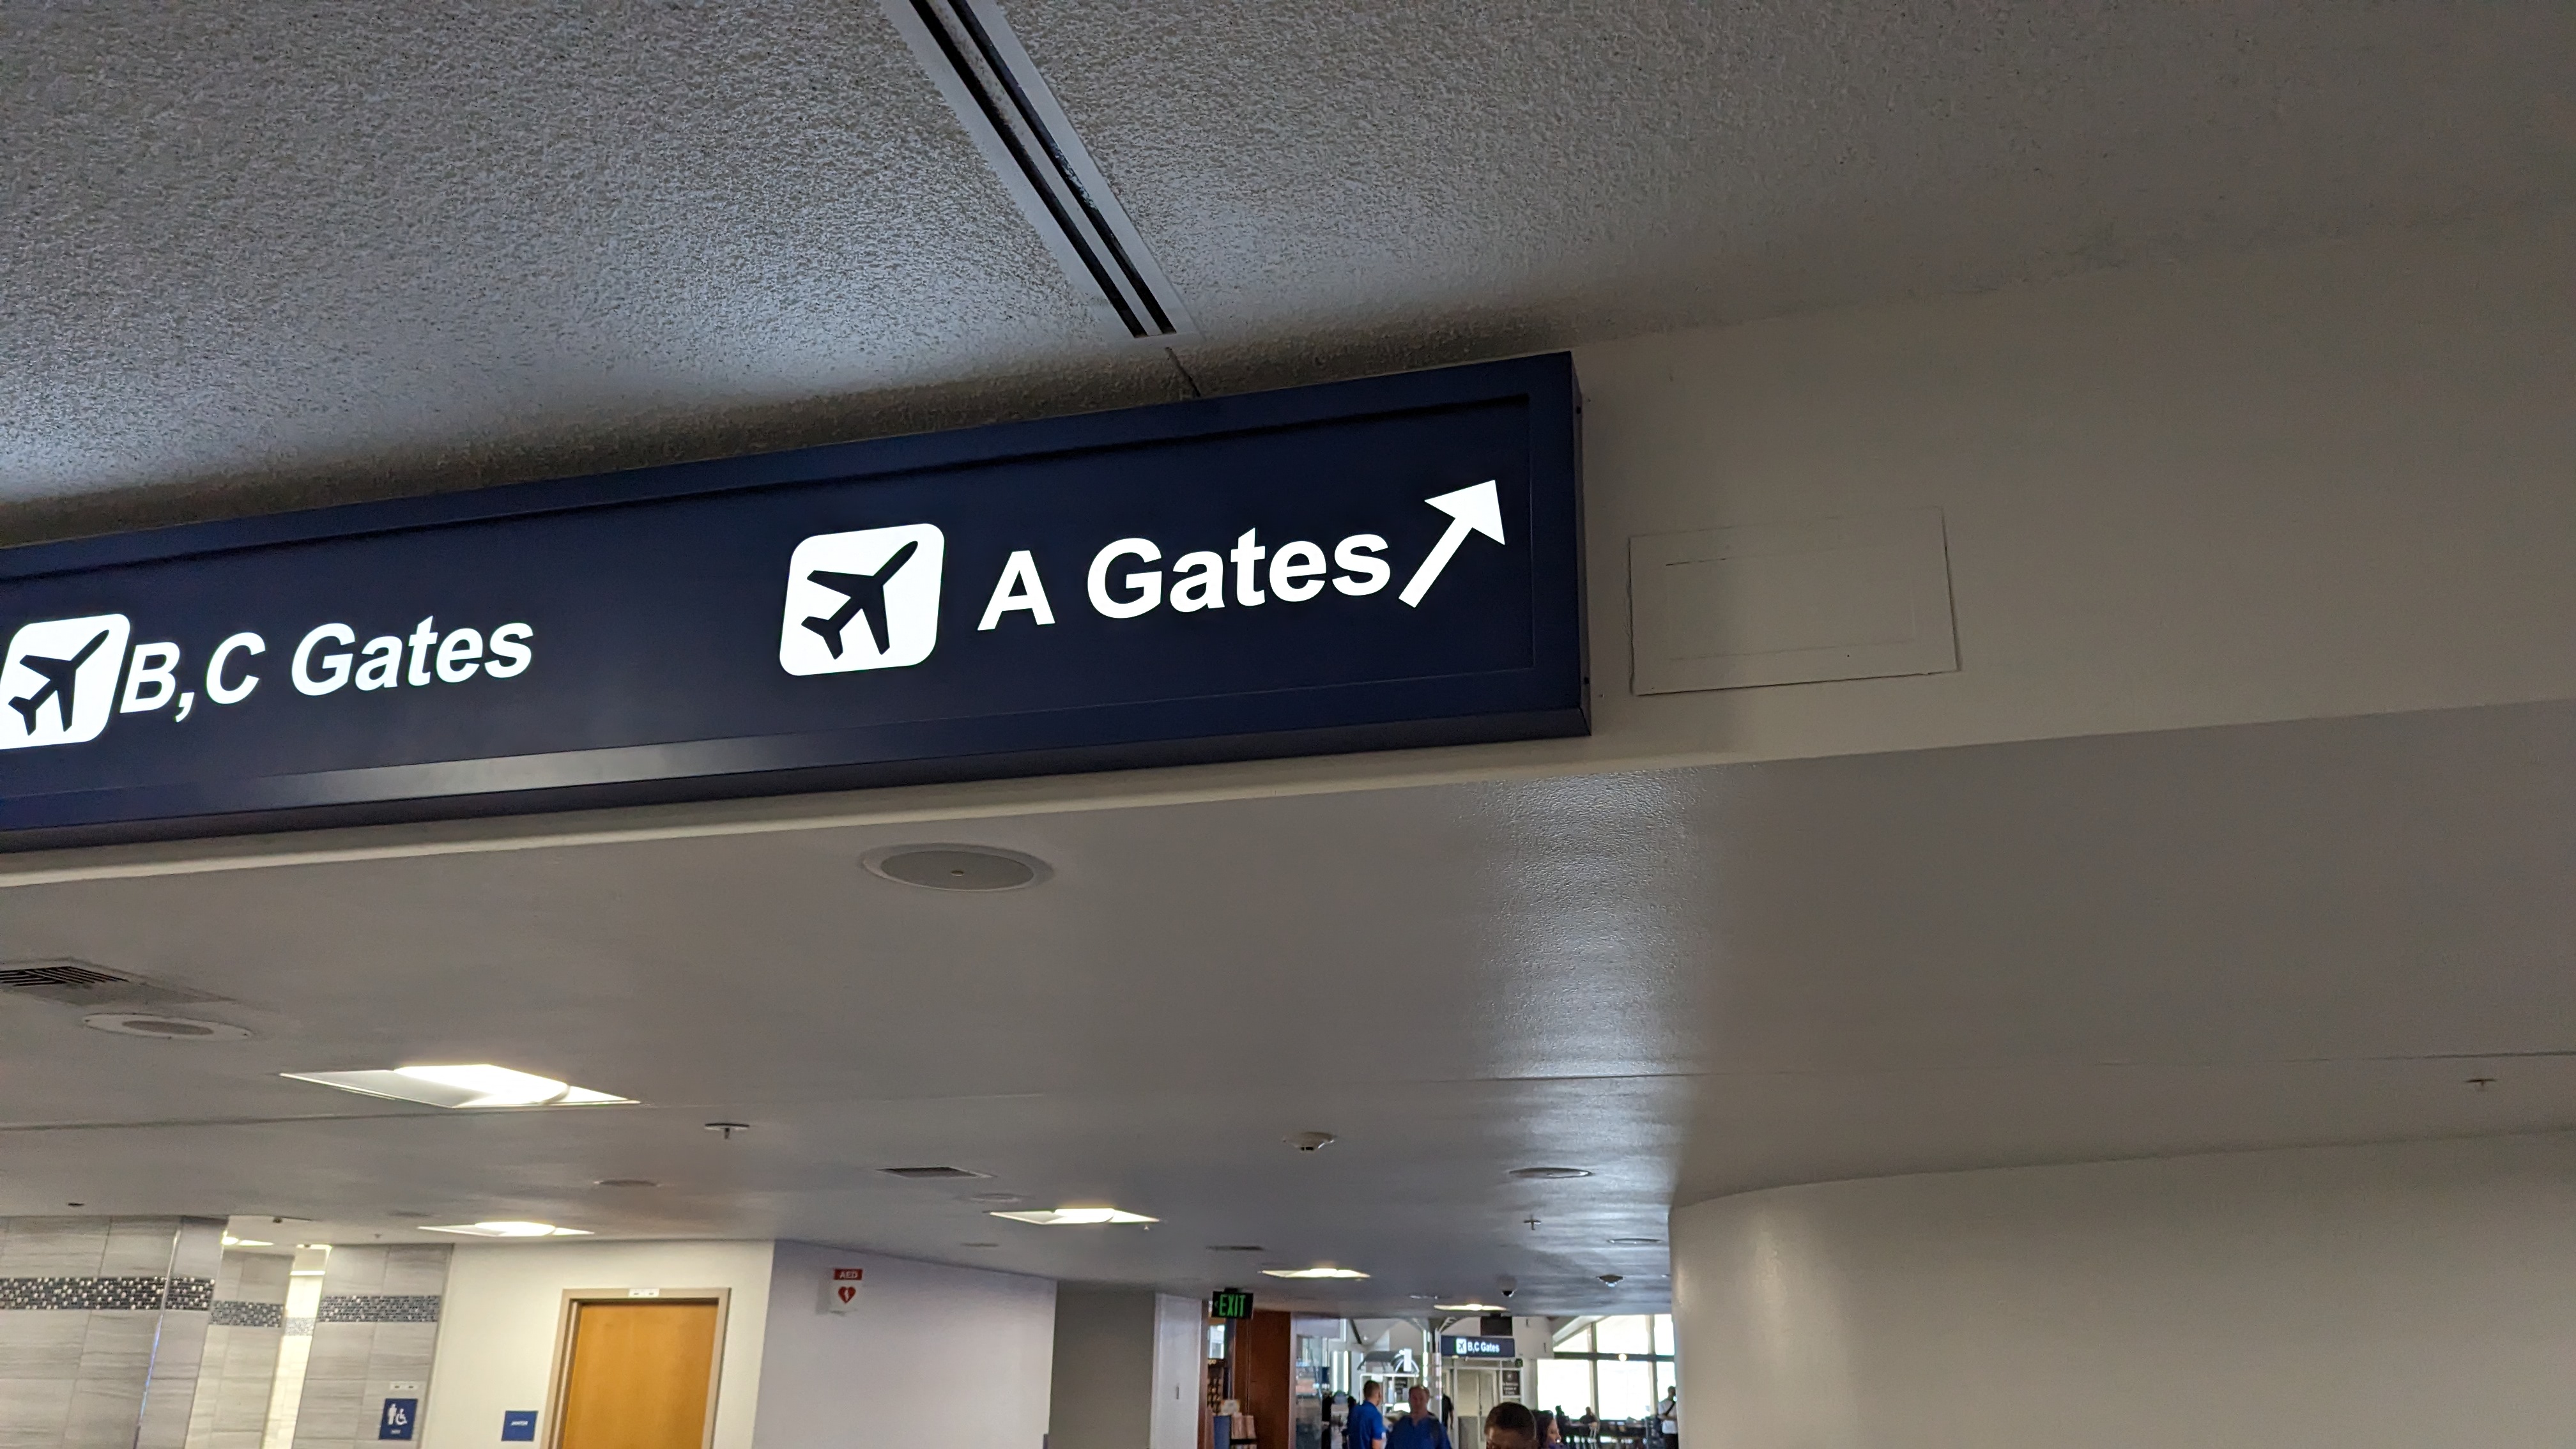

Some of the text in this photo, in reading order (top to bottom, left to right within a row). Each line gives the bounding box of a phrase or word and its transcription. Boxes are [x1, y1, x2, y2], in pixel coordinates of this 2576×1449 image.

[977, 528, 1390, 631] A Gates
[119, 615, 533, 723] B,C Gates
[1219, 1294, 1246, 1317] EXIT
[1468, 1341, 1500, 1353] B,C Gates
